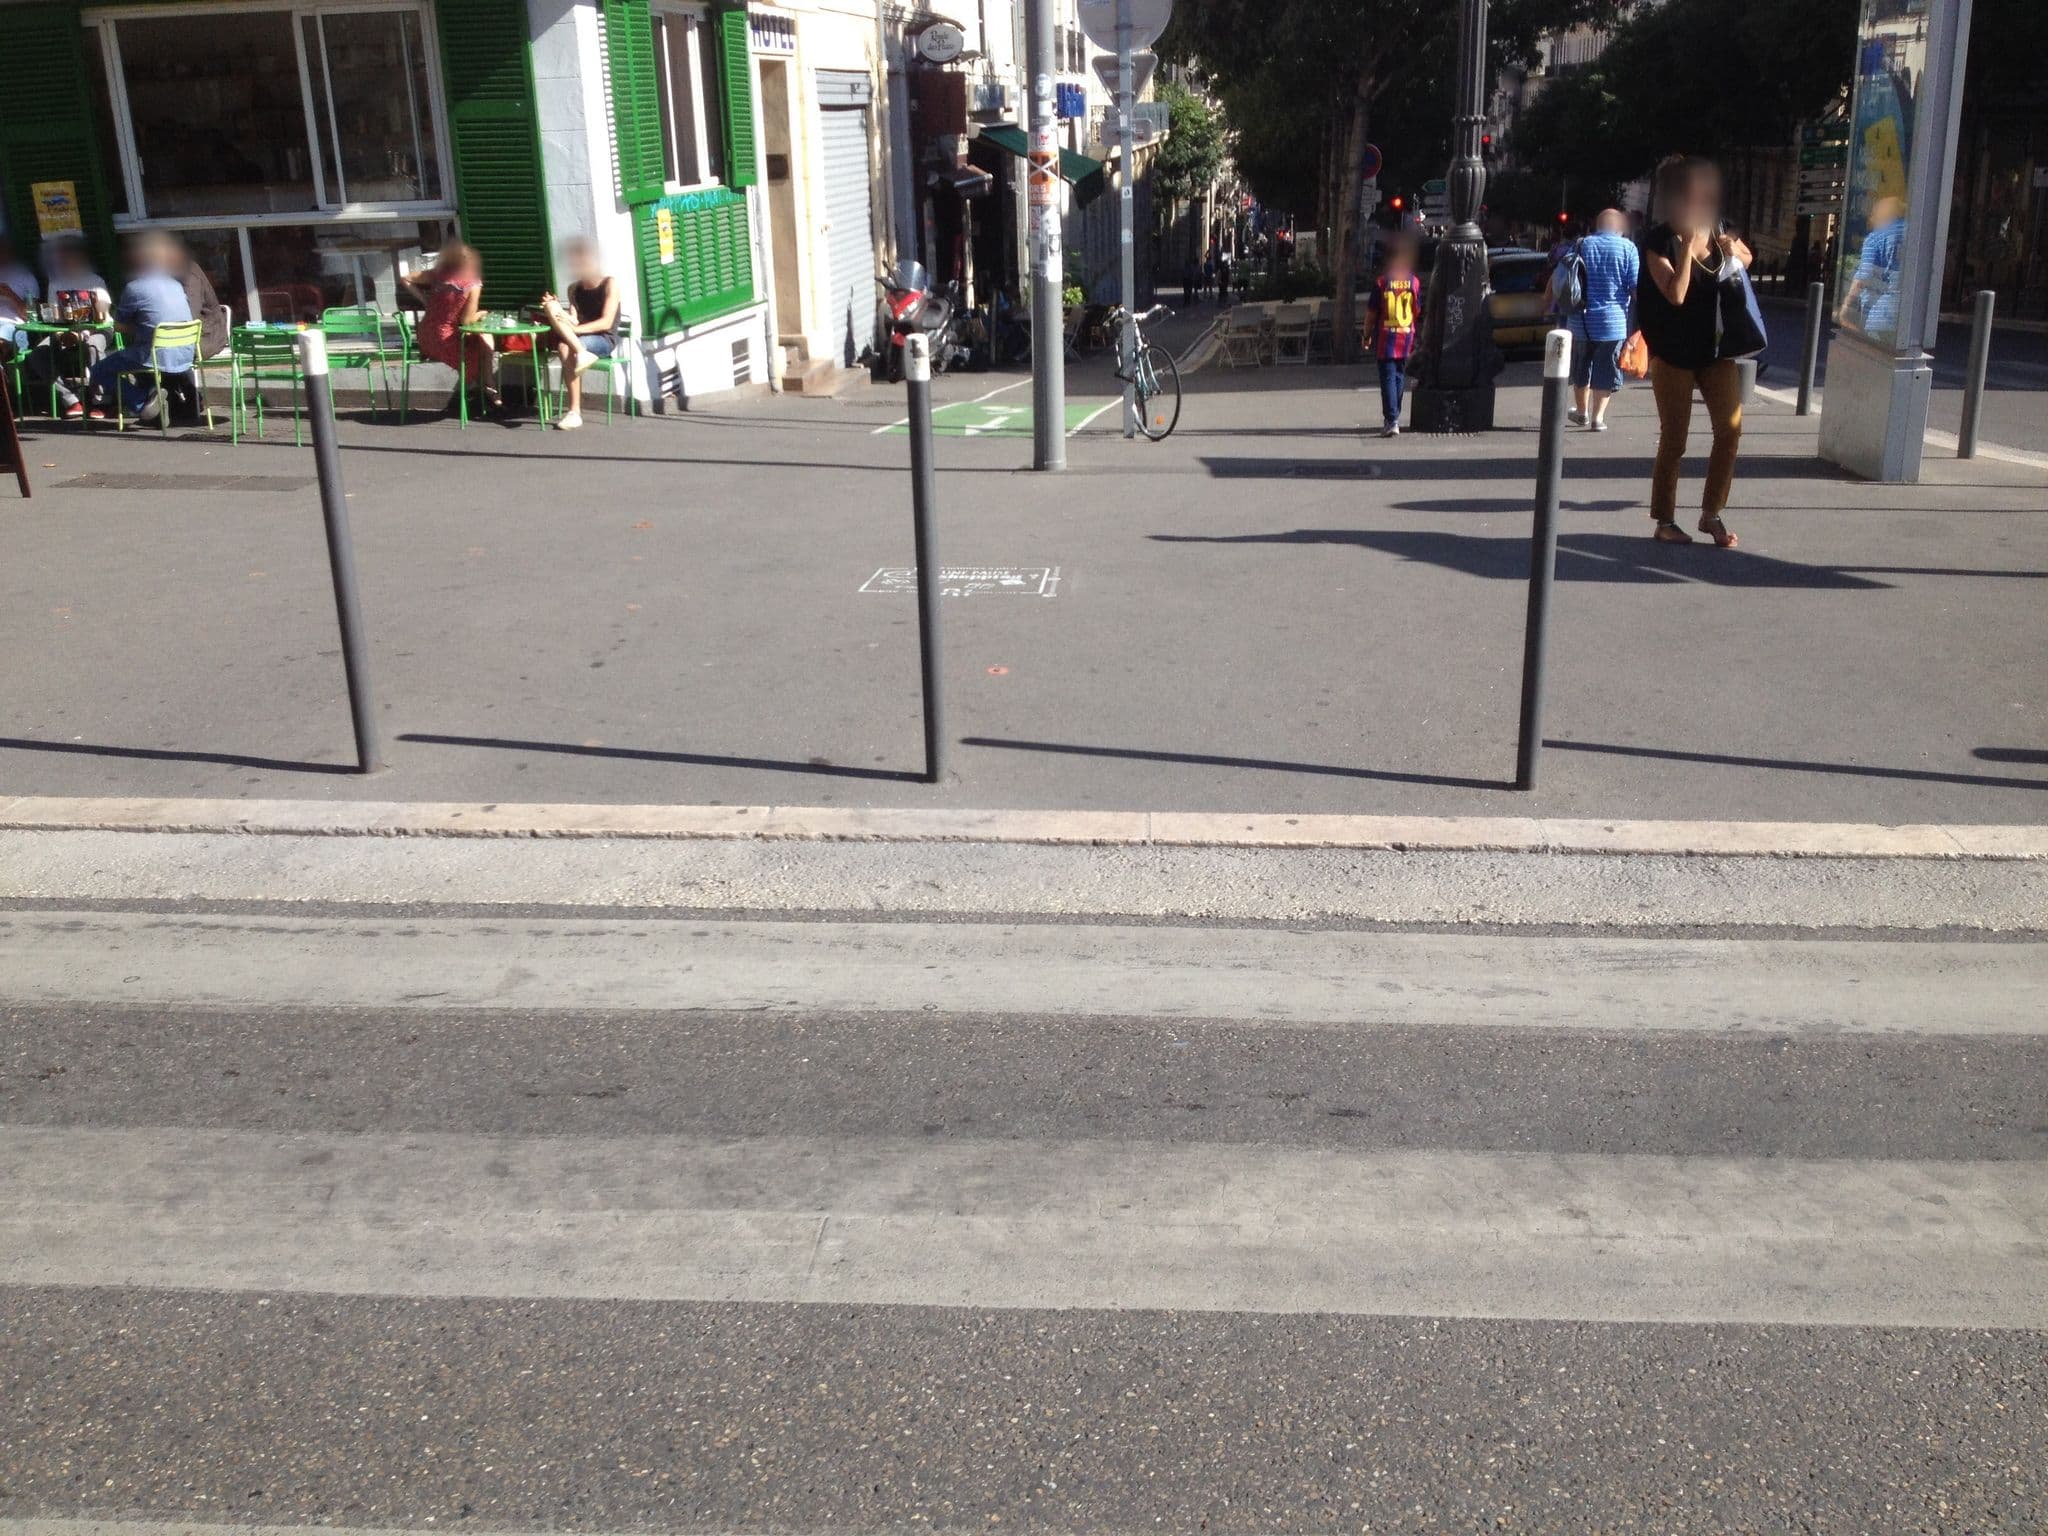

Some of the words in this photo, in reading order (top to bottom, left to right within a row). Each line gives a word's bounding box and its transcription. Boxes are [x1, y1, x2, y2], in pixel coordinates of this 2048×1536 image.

[749, 12, 796, 50] HOTEL
[1390, 280, 1411, 289] MESSI
[1384, 291, 1413, 327] 10
